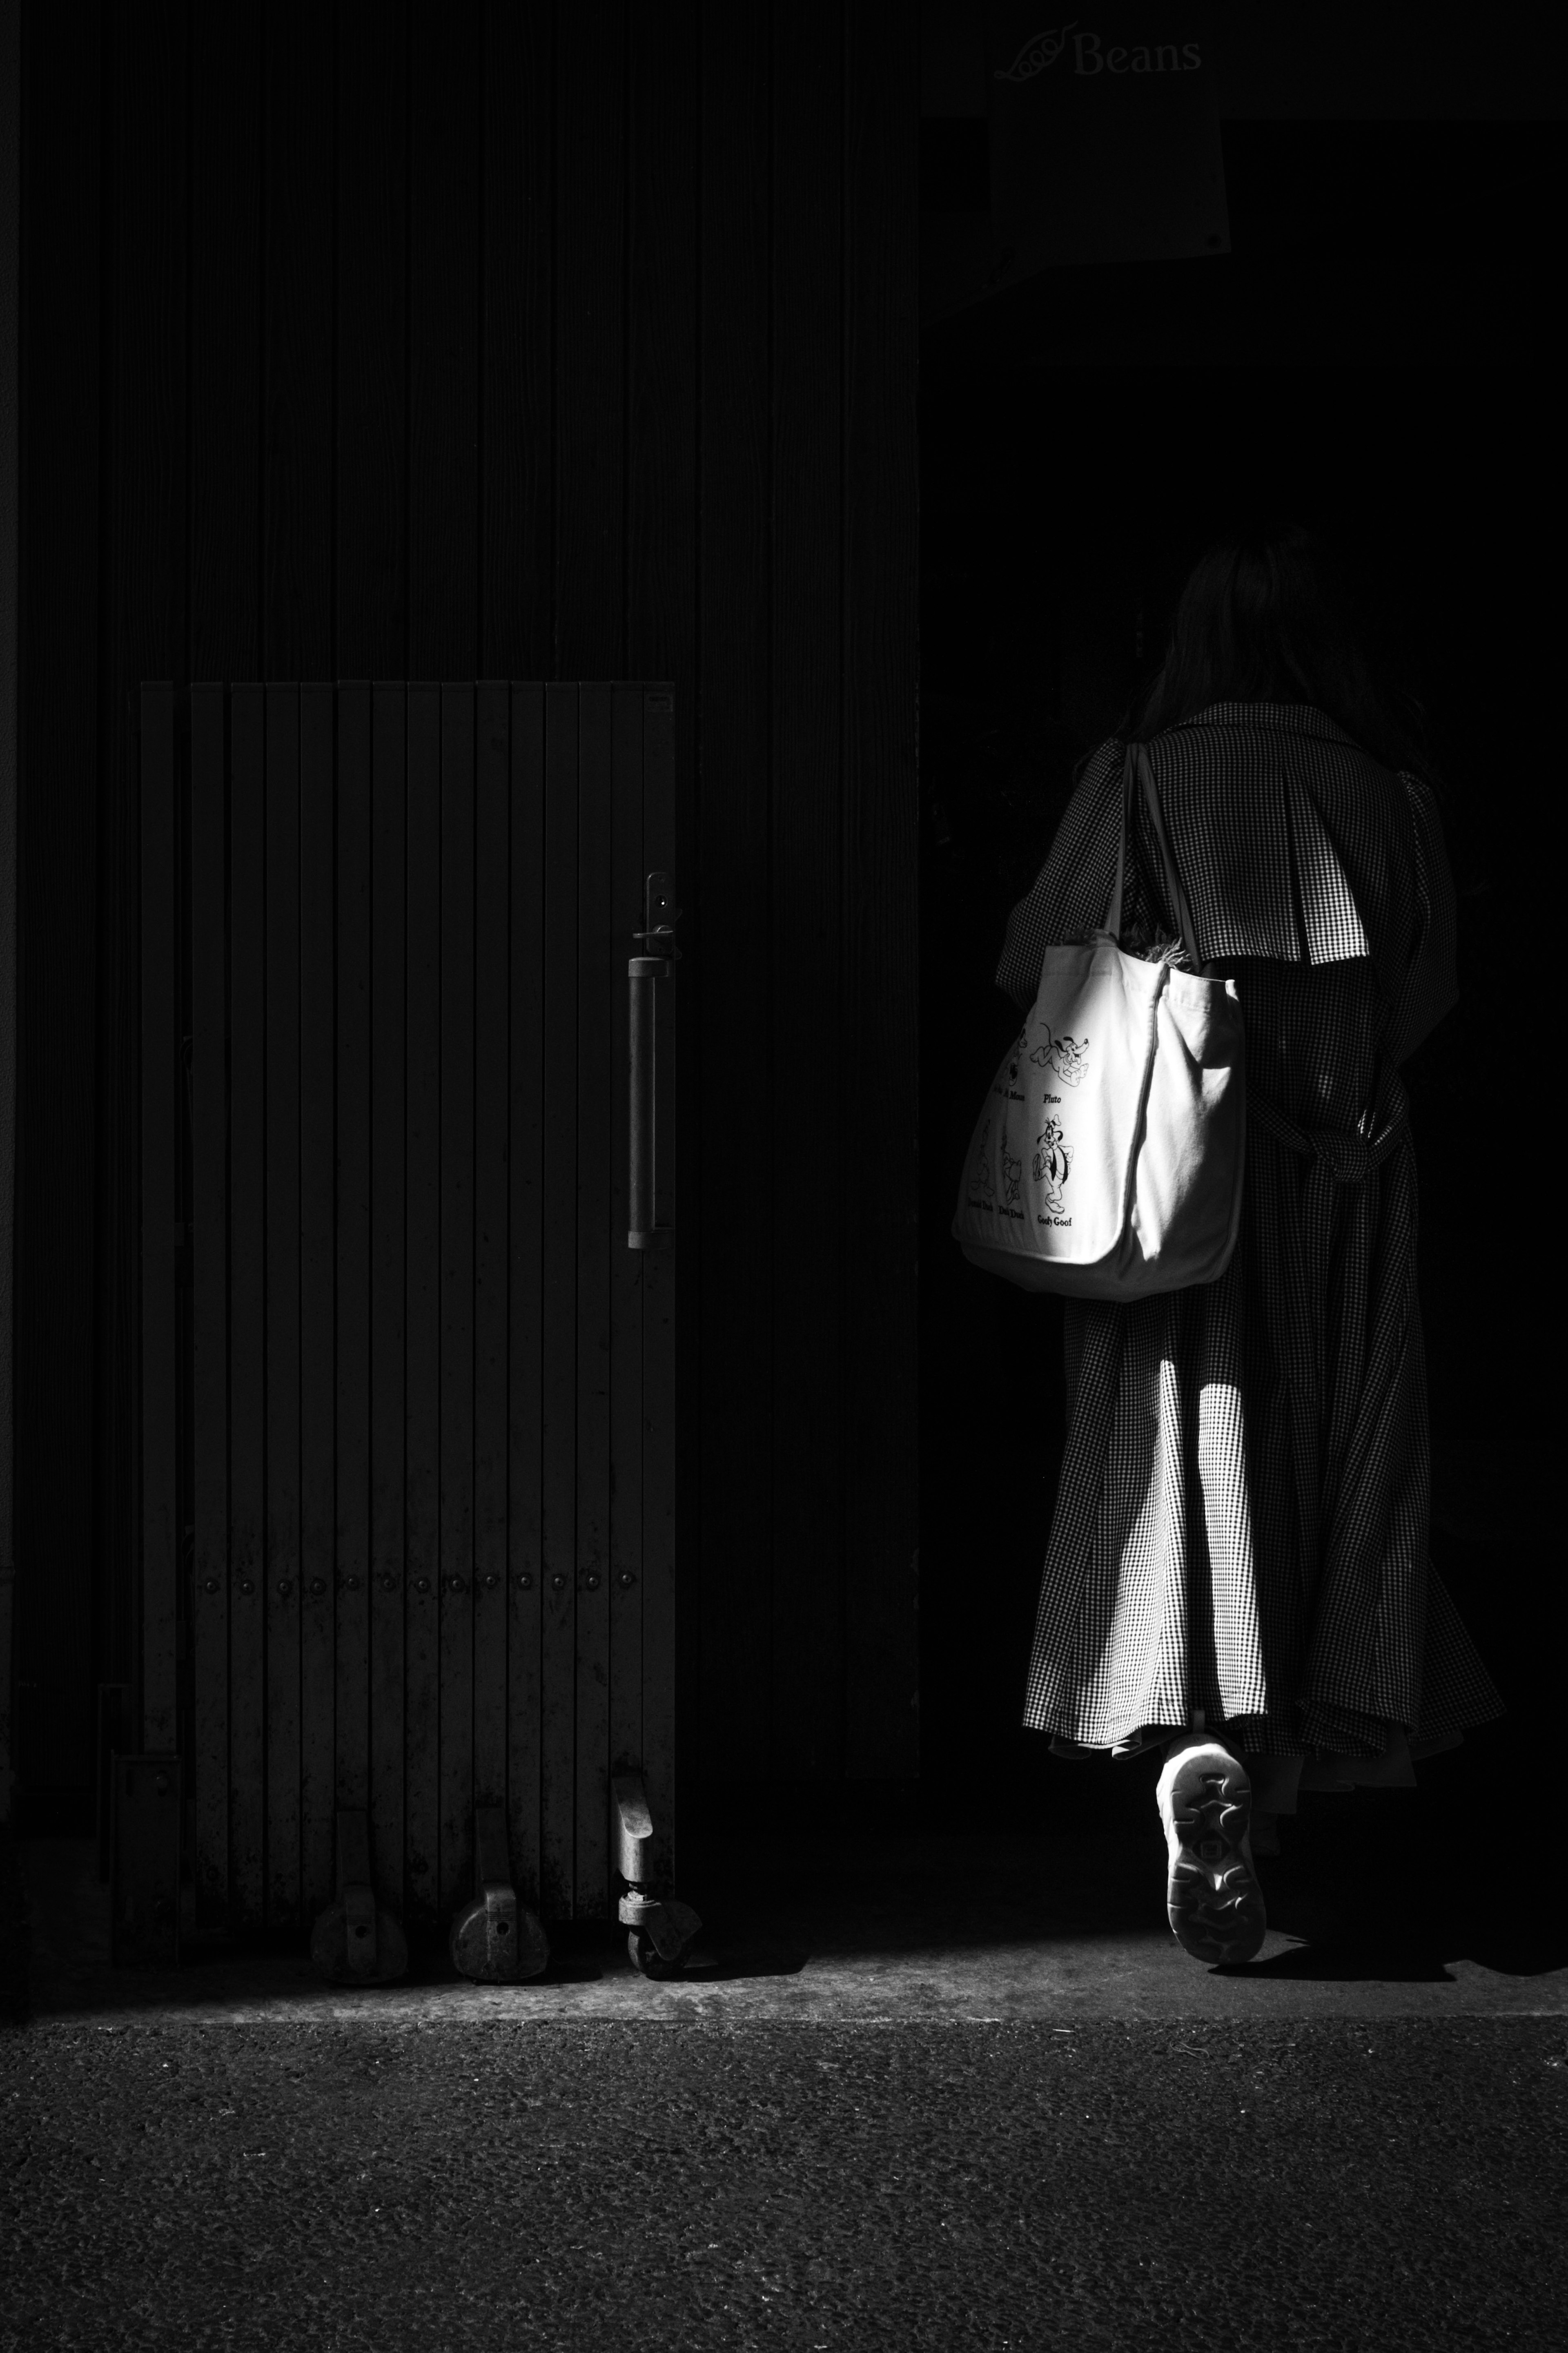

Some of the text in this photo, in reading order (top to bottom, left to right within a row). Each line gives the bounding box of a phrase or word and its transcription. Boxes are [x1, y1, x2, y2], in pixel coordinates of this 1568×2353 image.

[1072, 32, 1202, 75] Beans
[1043, 1094, 1061, 1104] Pluto
[1054, 1217, 1071, 1226] Goof
